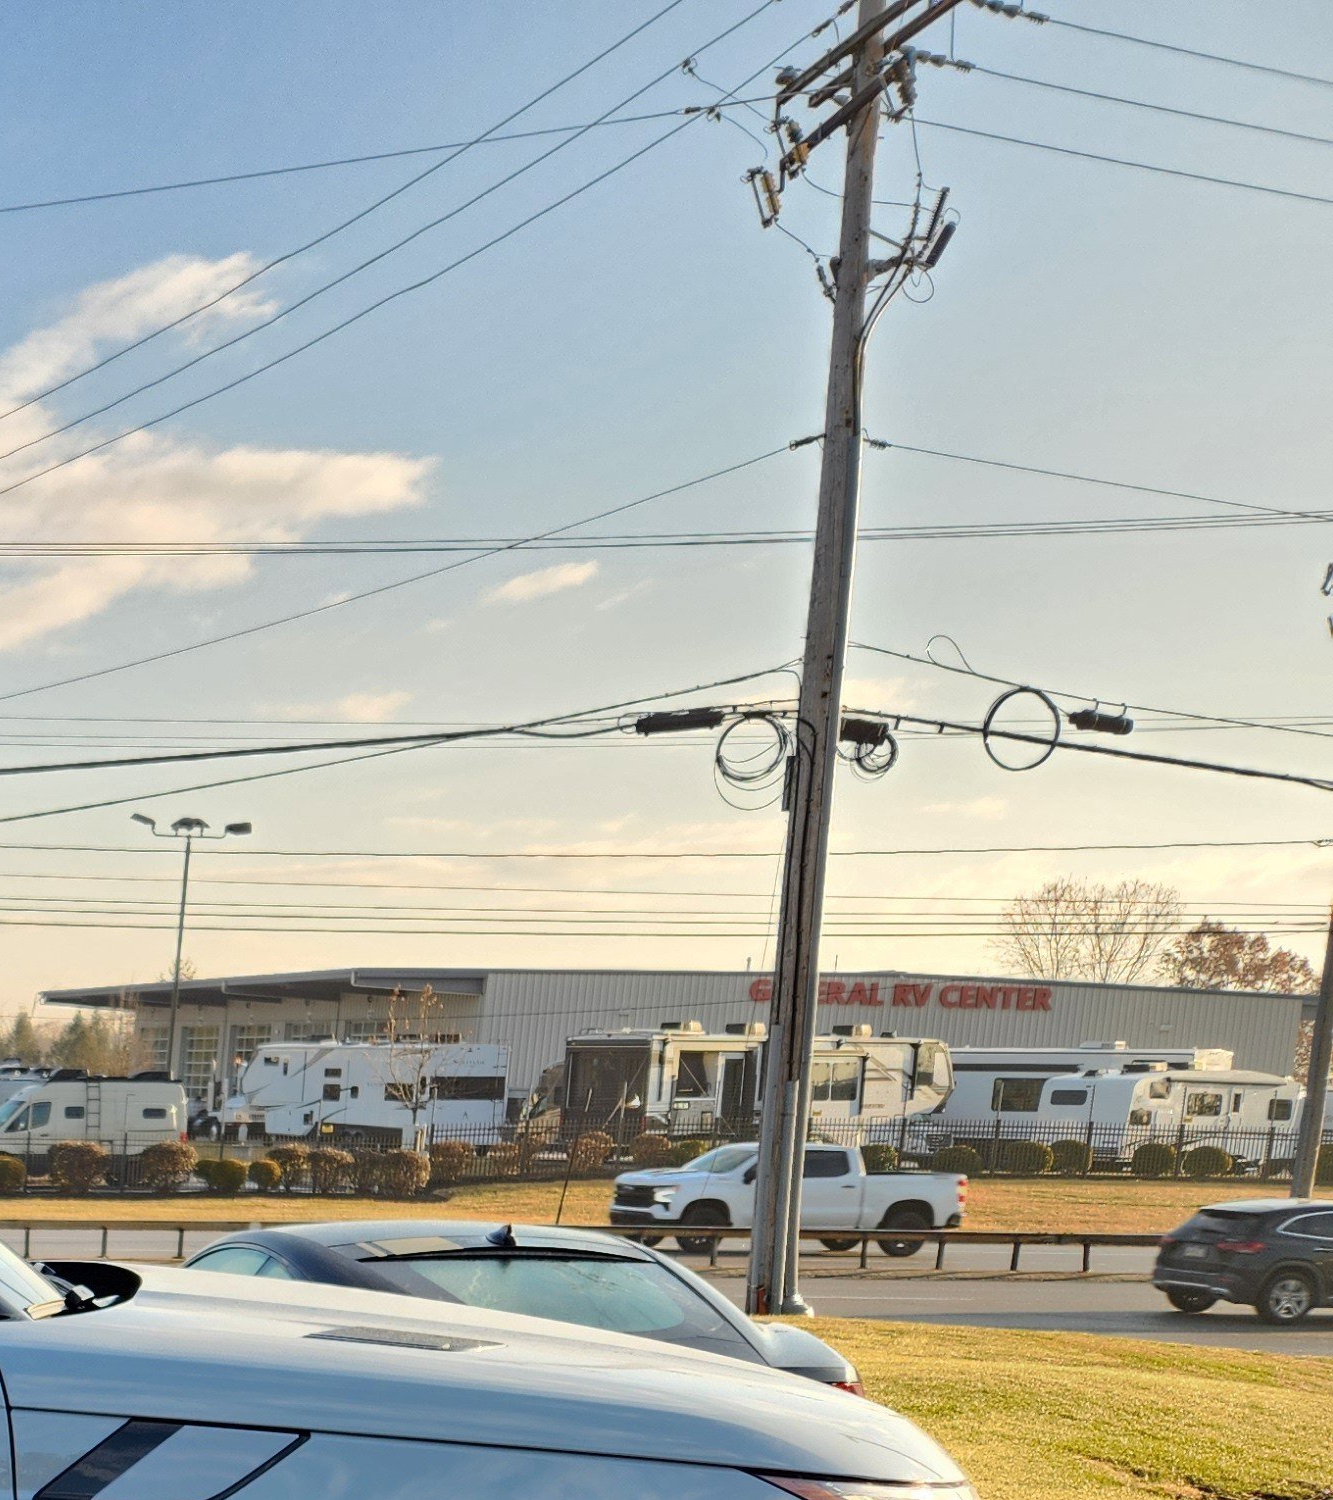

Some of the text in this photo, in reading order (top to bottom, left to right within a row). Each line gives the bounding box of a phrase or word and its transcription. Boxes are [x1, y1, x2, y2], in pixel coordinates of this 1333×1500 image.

[749, 979, 1052, 1011] GERAL RV CENTER
